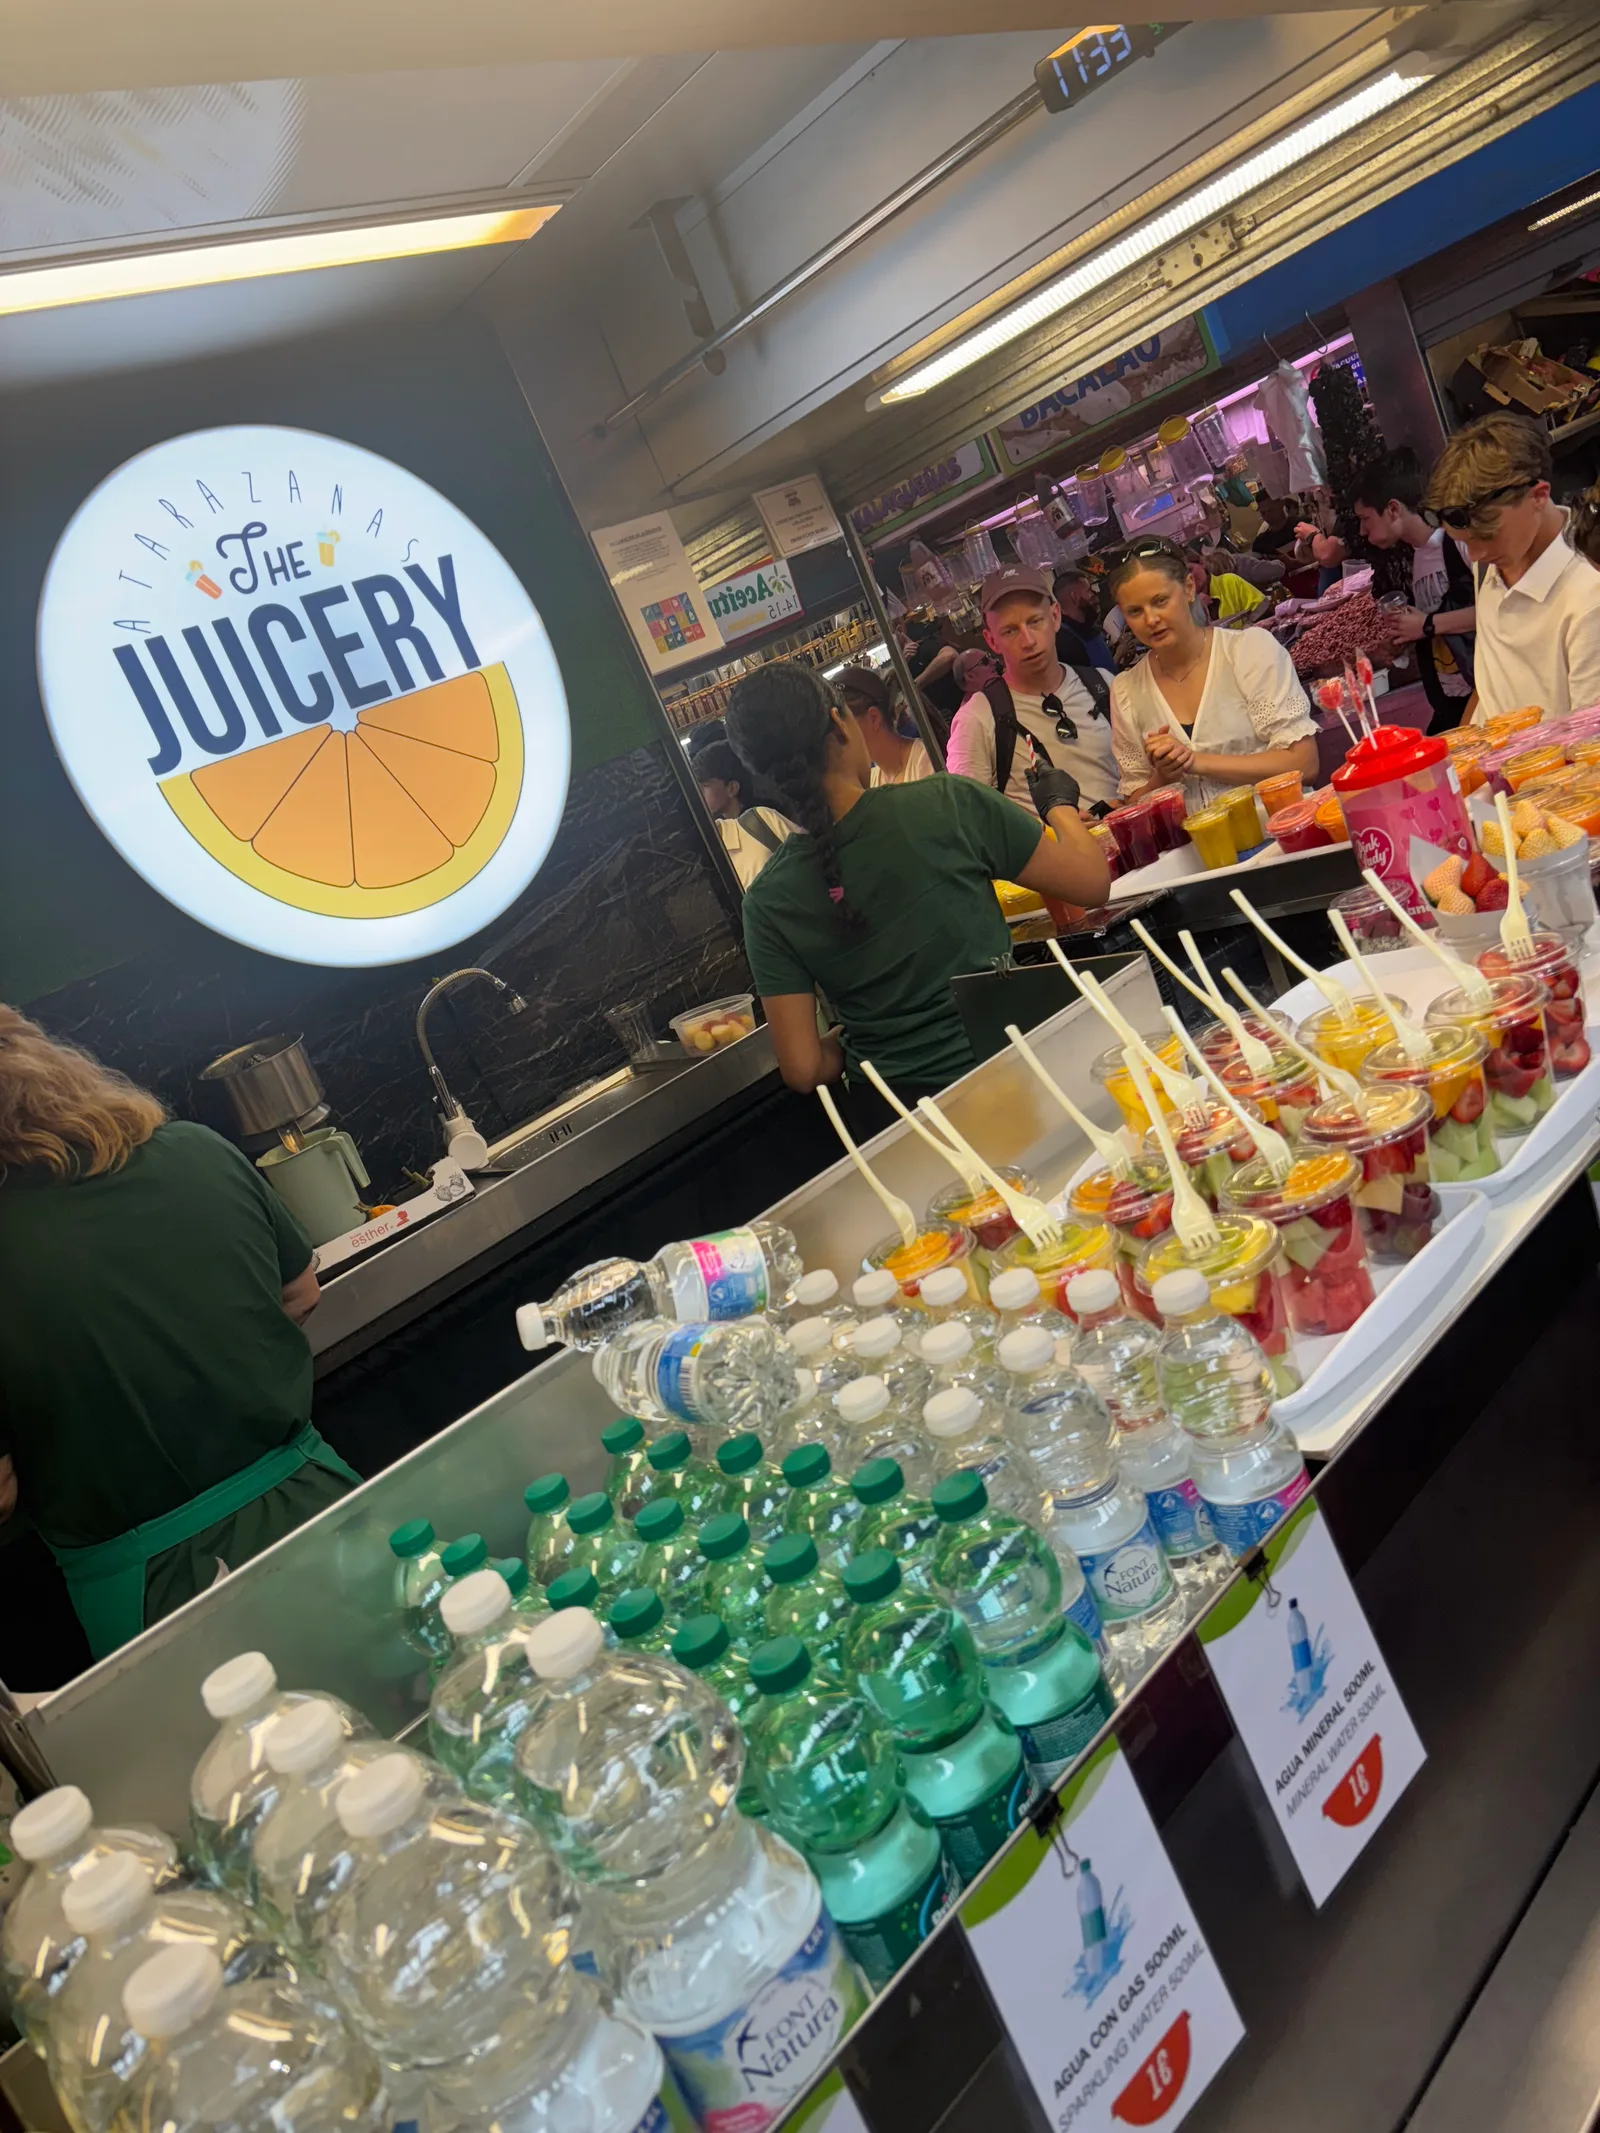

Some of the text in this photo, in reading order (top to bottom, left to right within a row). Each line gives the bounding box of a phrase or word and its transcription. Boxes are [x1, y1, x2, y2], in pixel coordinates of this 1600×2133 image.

[1020, 333, 1162, 430] BACALAO
[113, 470, 419, 634] ATARAZANAS
[112, 553, 482, 776] JUICERY
[351, 1222, 389, 1248] esther
[1104, 1562, 1159, 1598] Natura
[1120, 1556, 1148, 1581] FONT
[1275, 1659, 1376, 1796] AGUA MINERAL 500ML
[1286, 1682, 1387, 1819] MINERAL WATER 500ML
[741, 1996, 839, 2093] Natura
[765, 1989, 815, 2050] FONT
[1054, 1923, 1187, 2099] AGUA CON GAS 500ML
[1058, 1940, 1204, 2133] SPARKLING WATER 500ML
